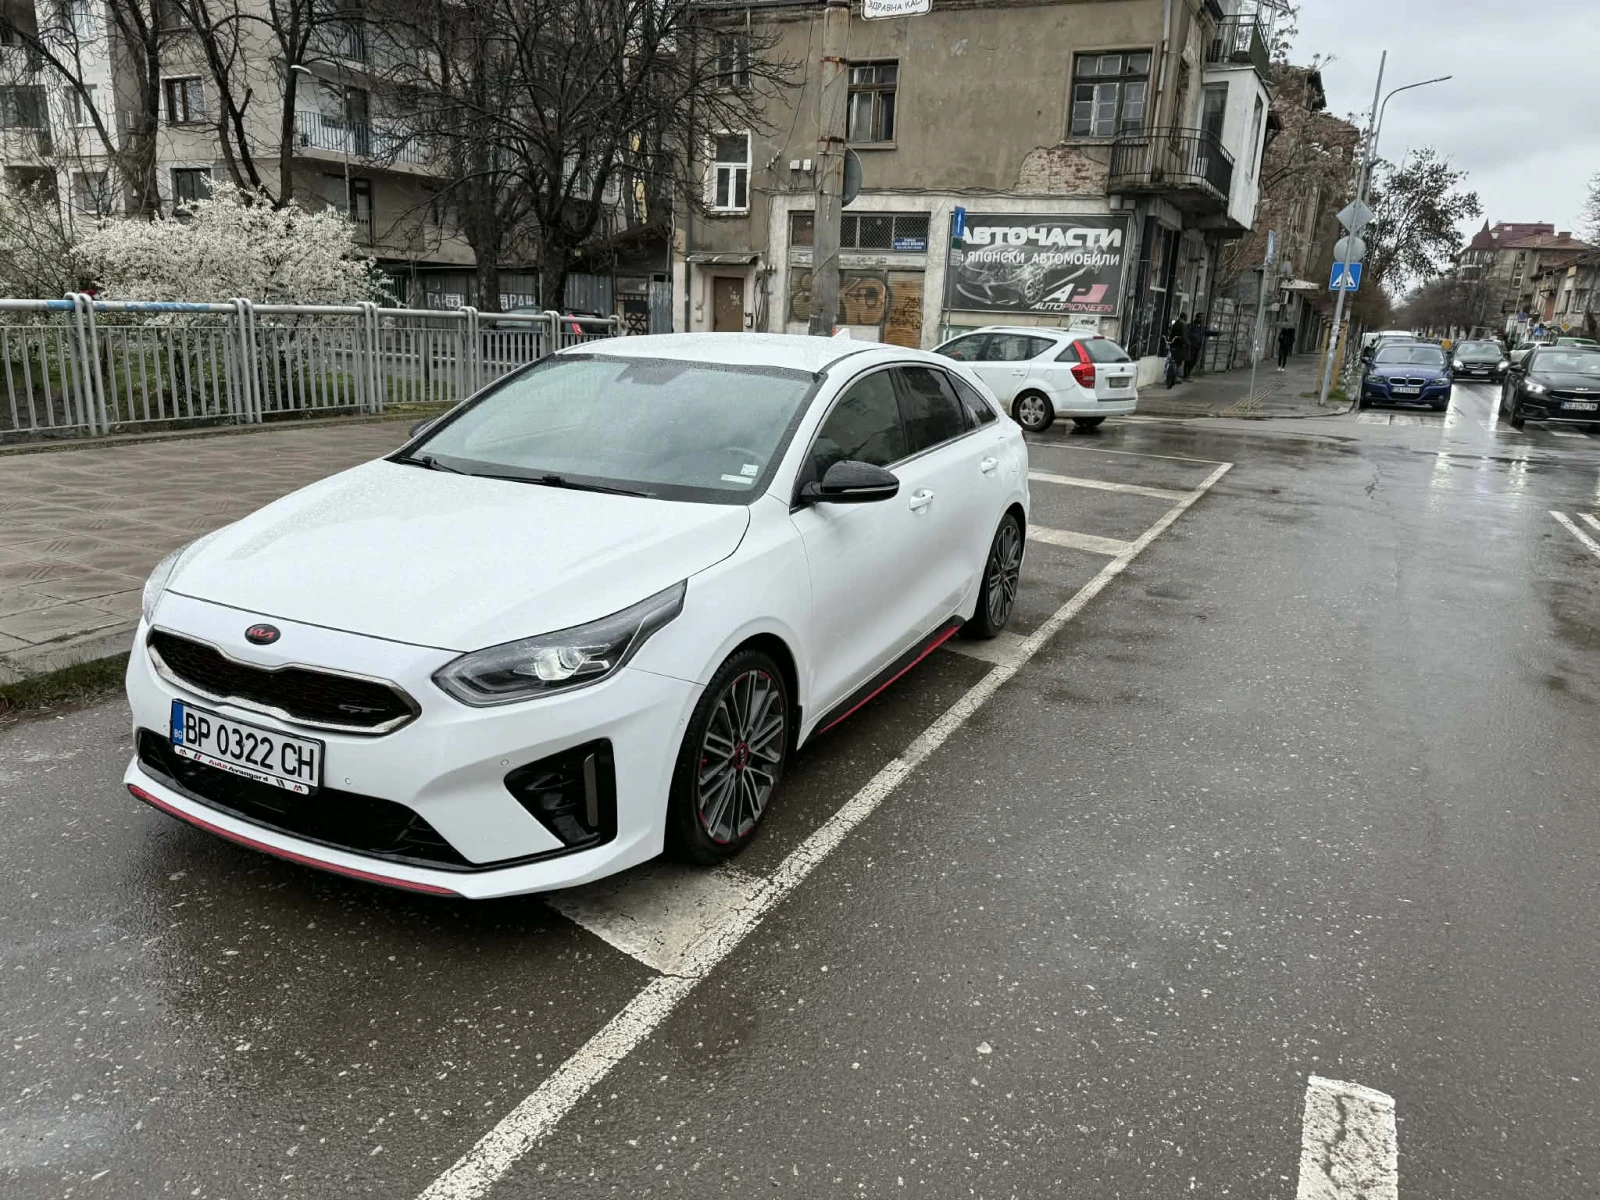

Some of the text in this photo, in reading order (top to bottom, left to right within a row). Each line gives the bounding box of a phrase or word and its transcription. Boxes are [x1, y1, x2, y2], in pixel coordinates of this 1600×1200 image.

[967, 251, 1025, 263] ЯПОНСКИ
[1031, 252, 1120, 266] АВТОМОБИЛИ
[1030, 302, 1113, 312] AUTOPIONEER
[173, 728, 183, 740] BG
[185, 712, 314, 781] BP 0322 CH
